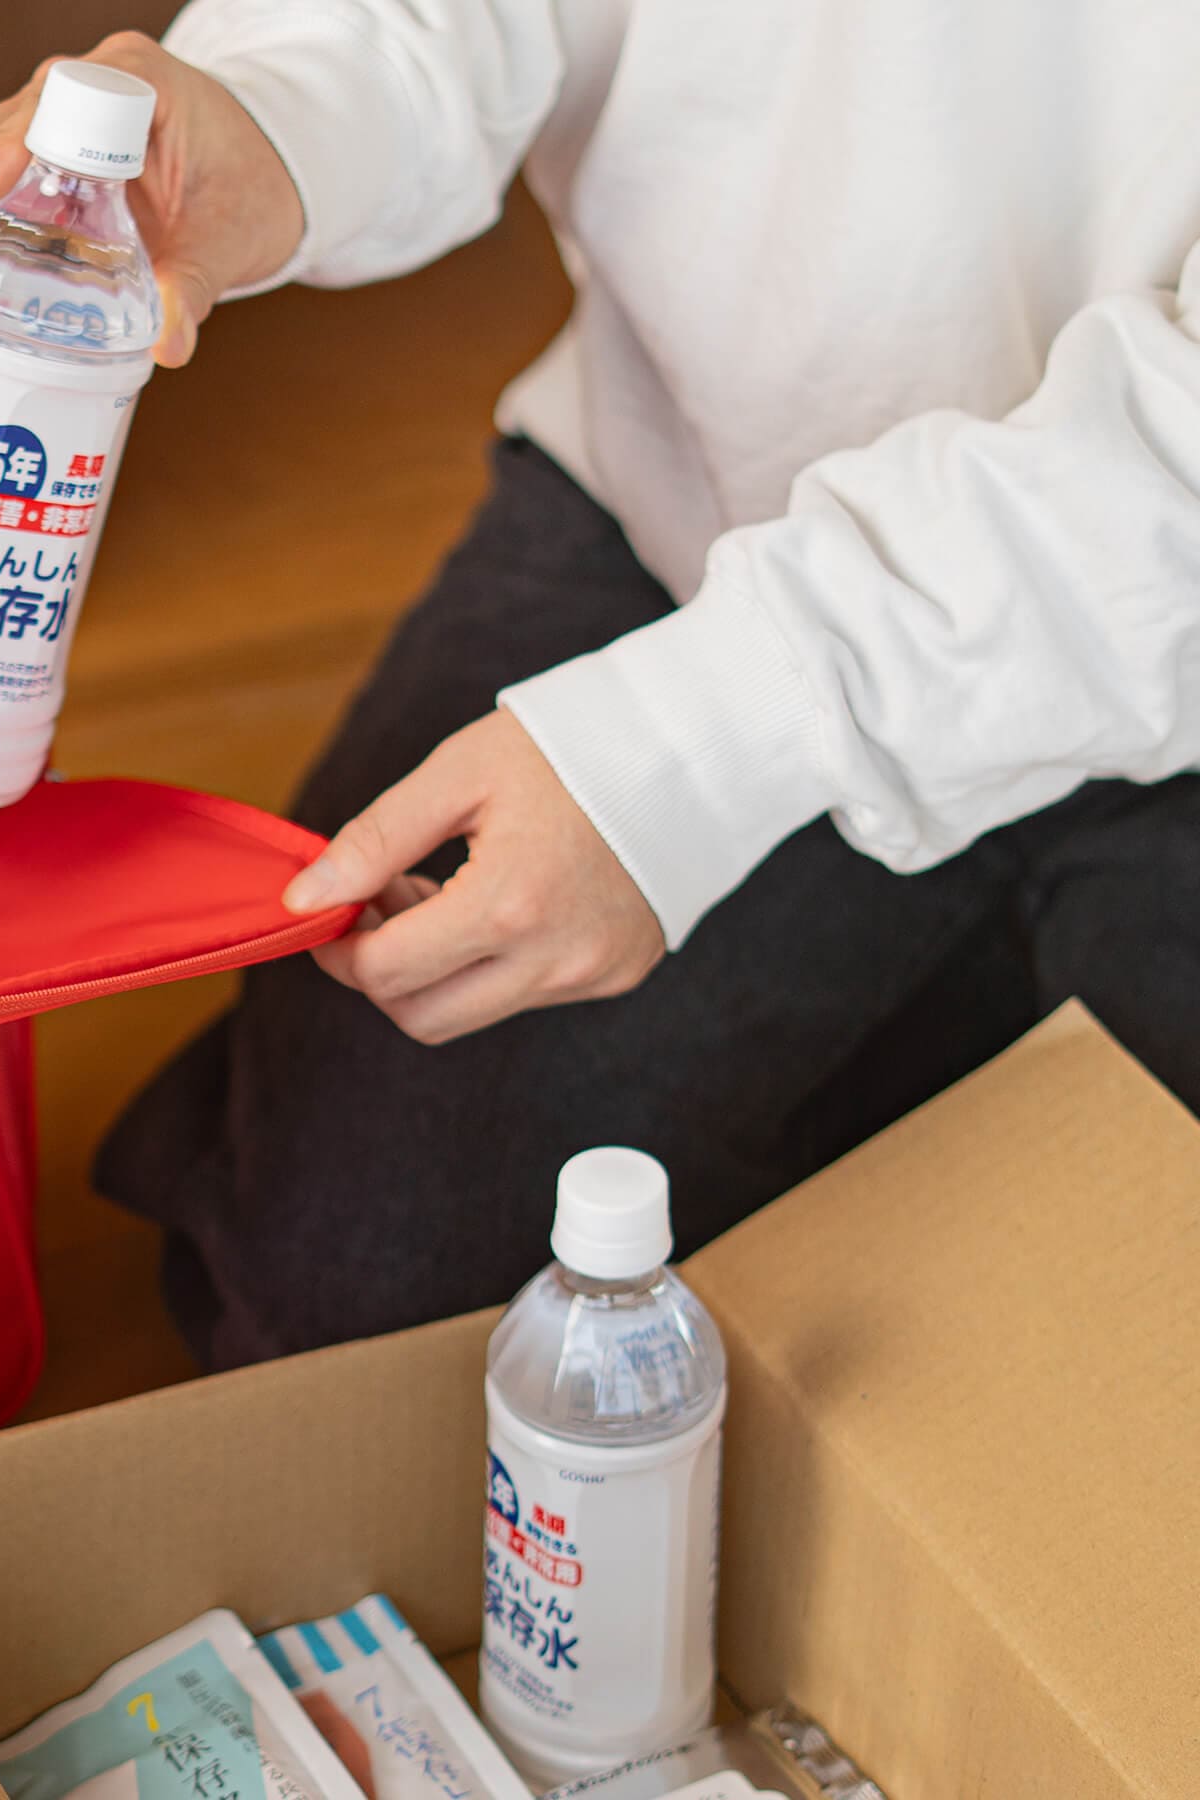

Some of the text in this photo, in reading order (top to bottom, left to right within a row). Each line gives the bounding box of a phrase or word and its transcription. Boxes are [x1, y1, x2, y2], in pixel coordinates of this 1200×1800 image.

[51, 481, 102, 499] 保存でき
[559, 1469, 606, 1485] GOSHU
[127, 1691, 161, 1732] 7
